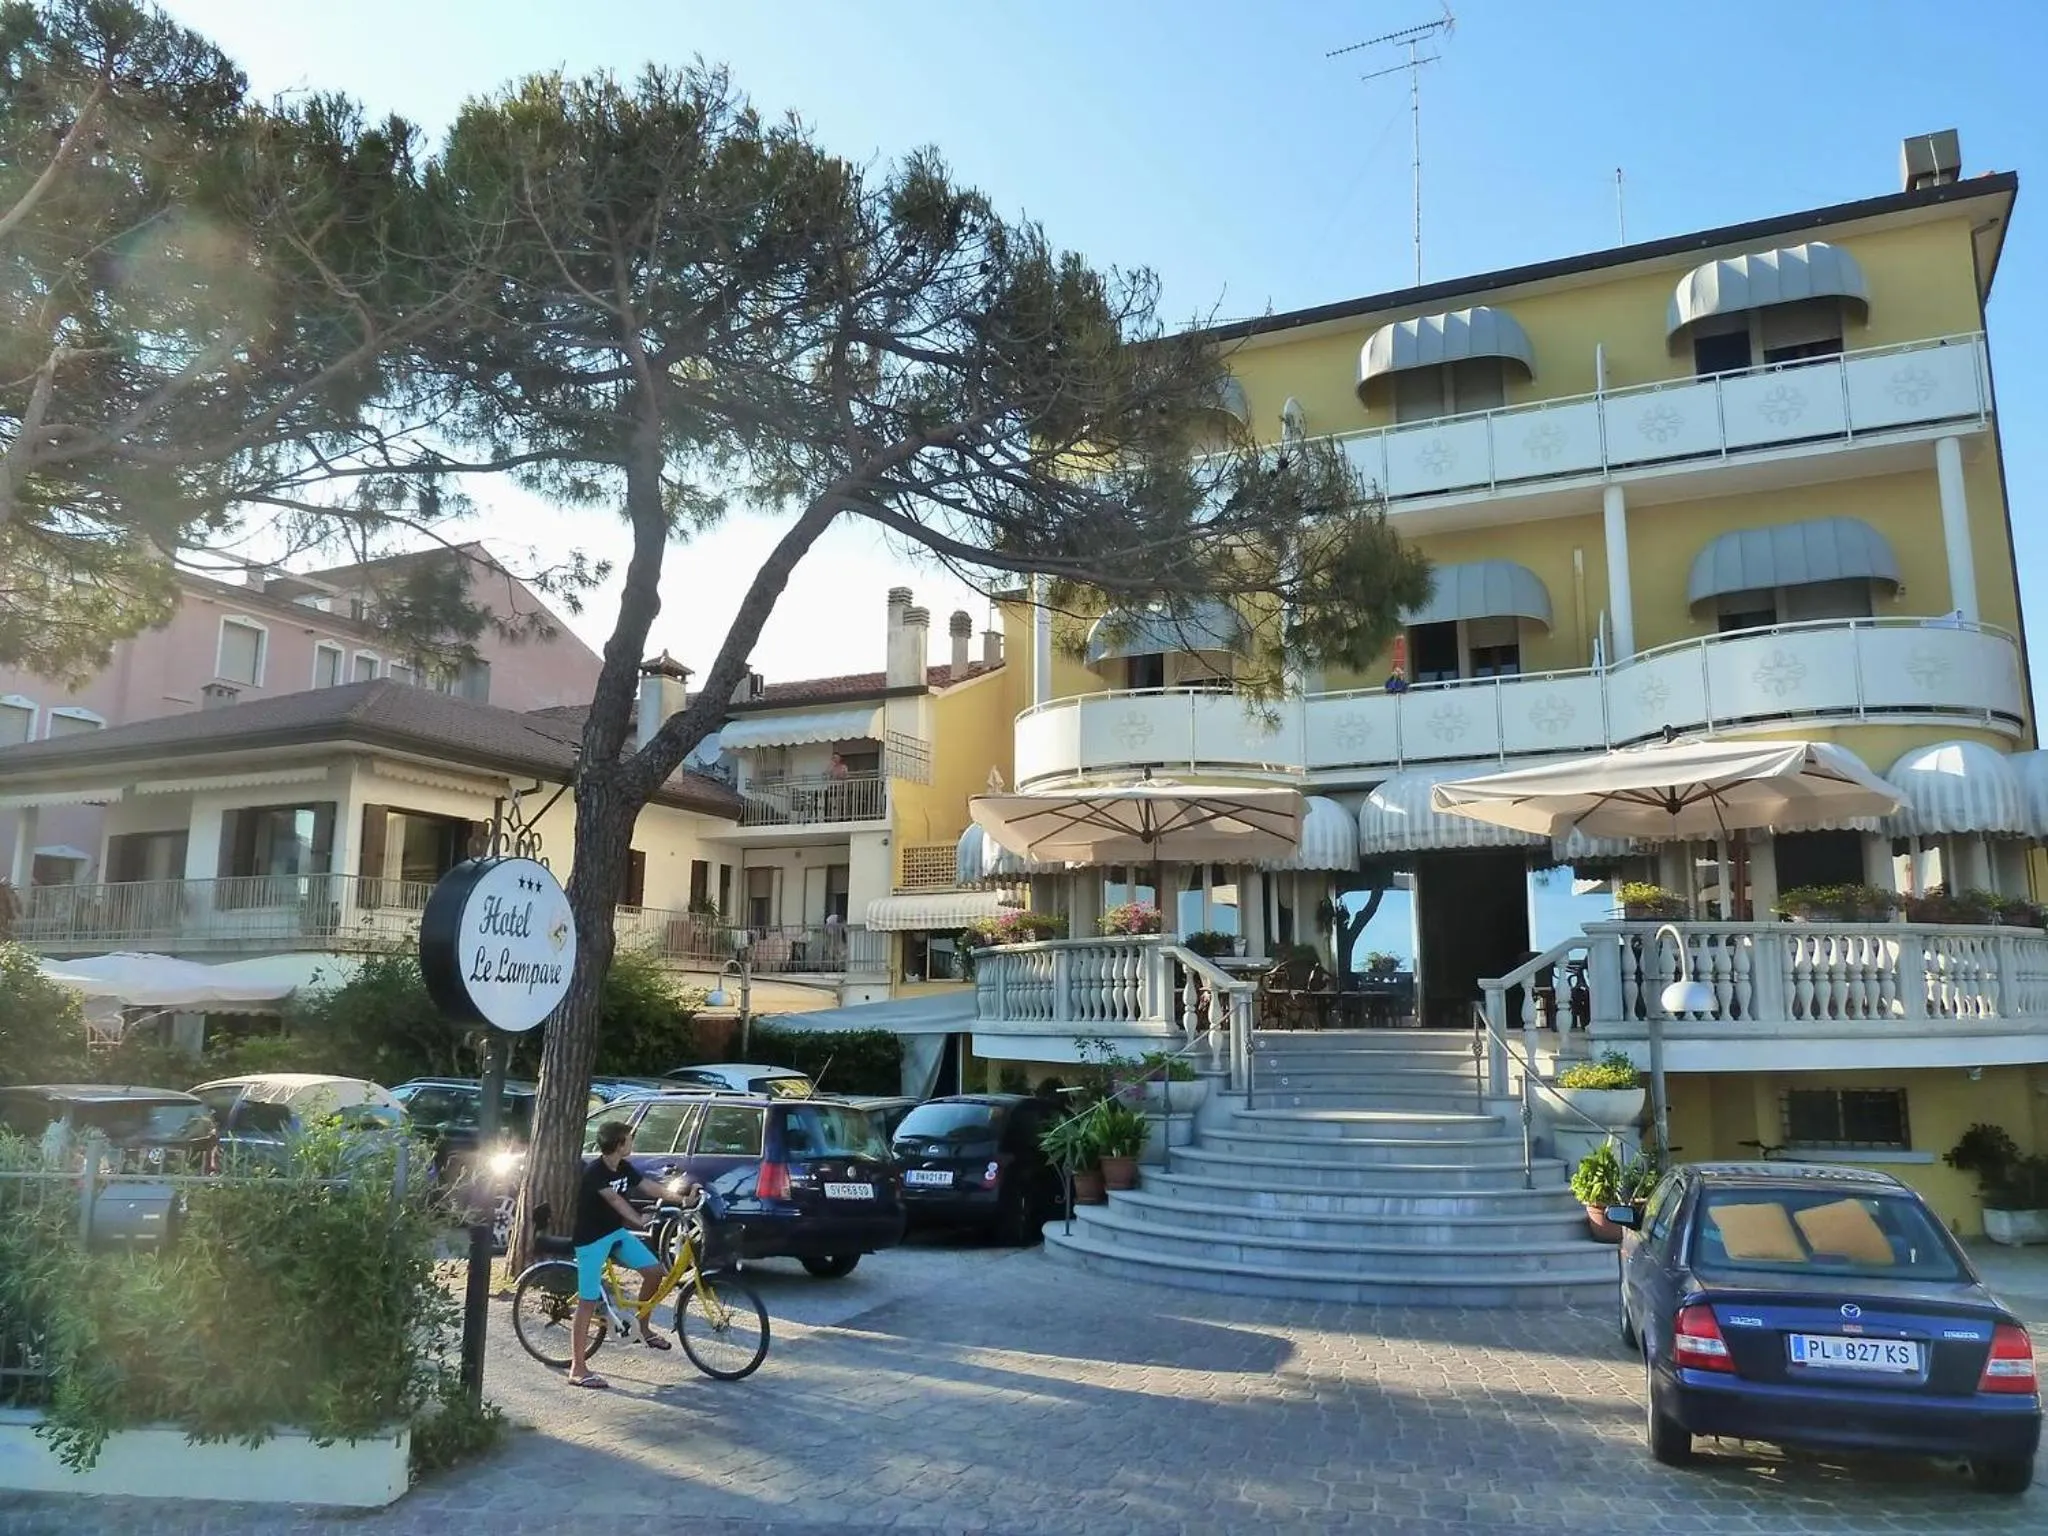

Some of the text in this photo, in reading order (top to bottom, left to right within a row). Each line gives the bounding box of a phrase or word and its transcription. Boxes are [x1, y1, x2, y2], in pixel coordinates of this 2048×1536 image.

[479, 895, 532, 938] Hotel
[470, 945, 563, 995] Le Lampare
[1808, 1340, 1910, 1364] PL 827 KS
